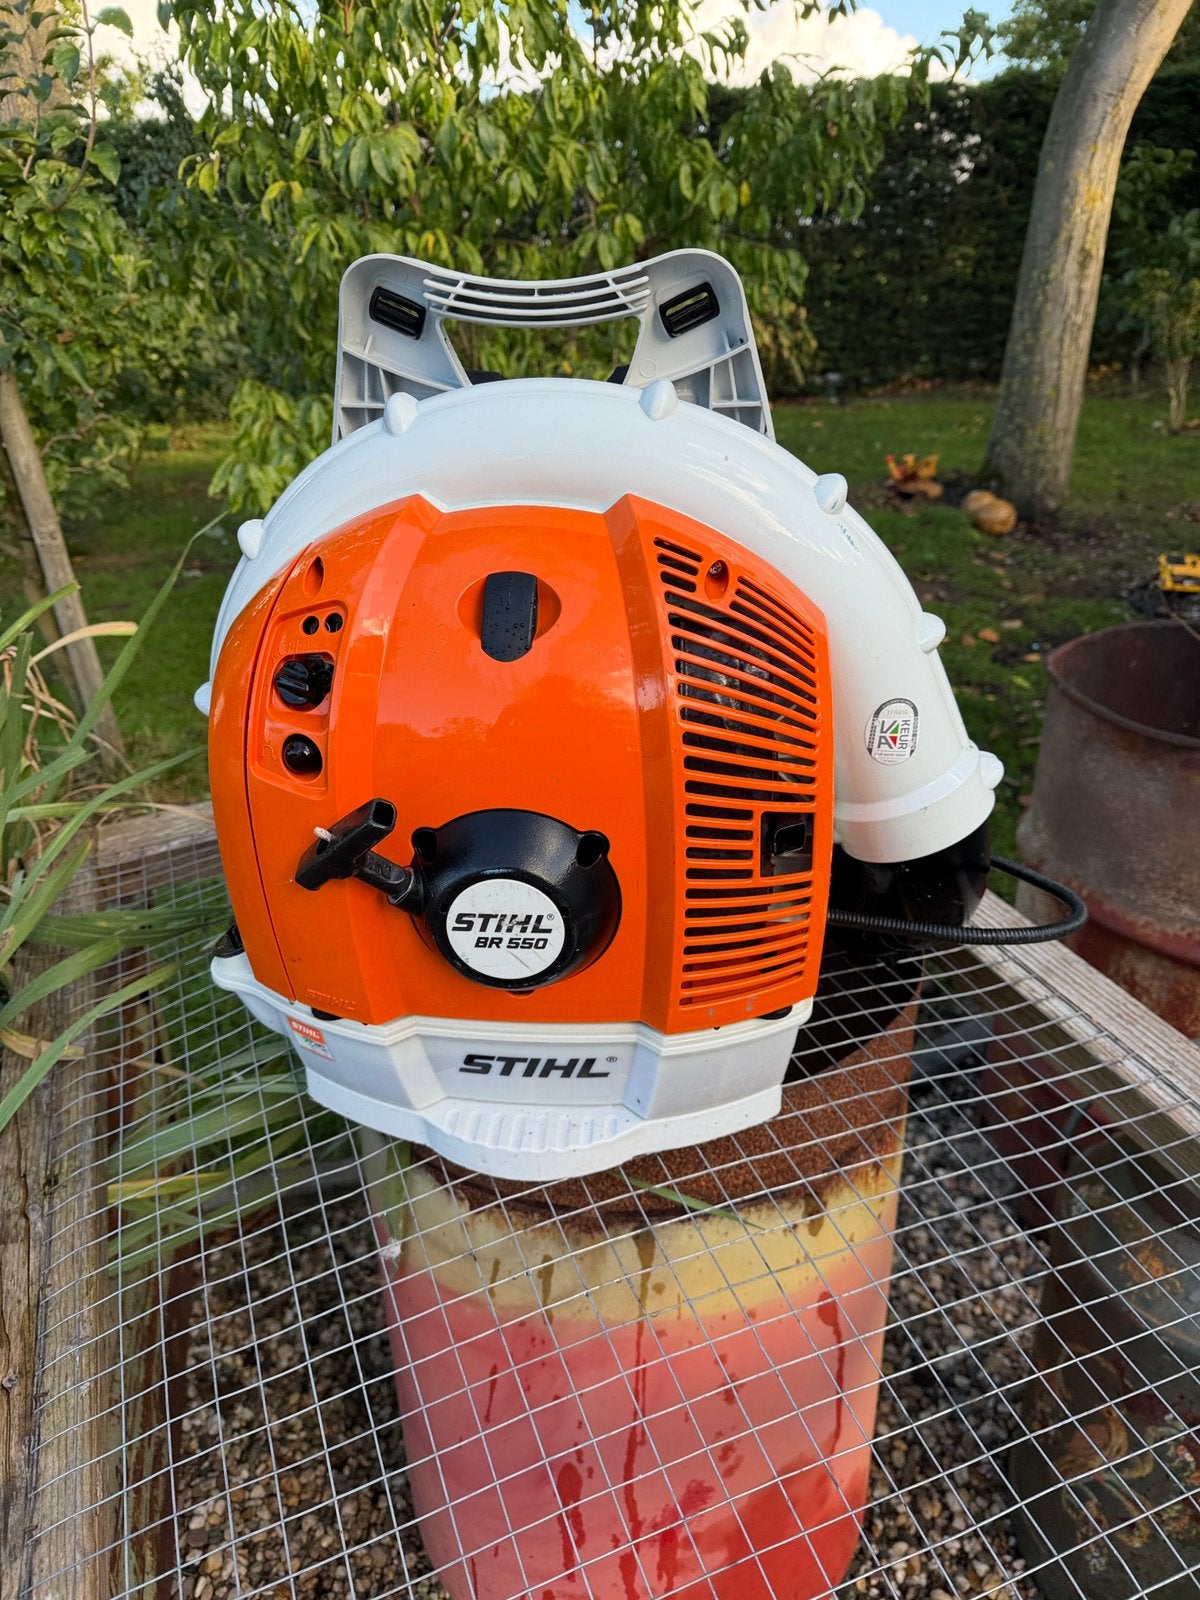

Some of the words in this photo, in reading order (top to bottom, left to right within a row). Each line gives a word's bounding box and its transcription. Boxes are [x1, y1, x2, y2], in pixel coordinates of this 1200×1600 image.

[898, 719, 911, 750] KEUR
[474, 936, 503, 949] BR
[506, 937, 549, 950] 550
